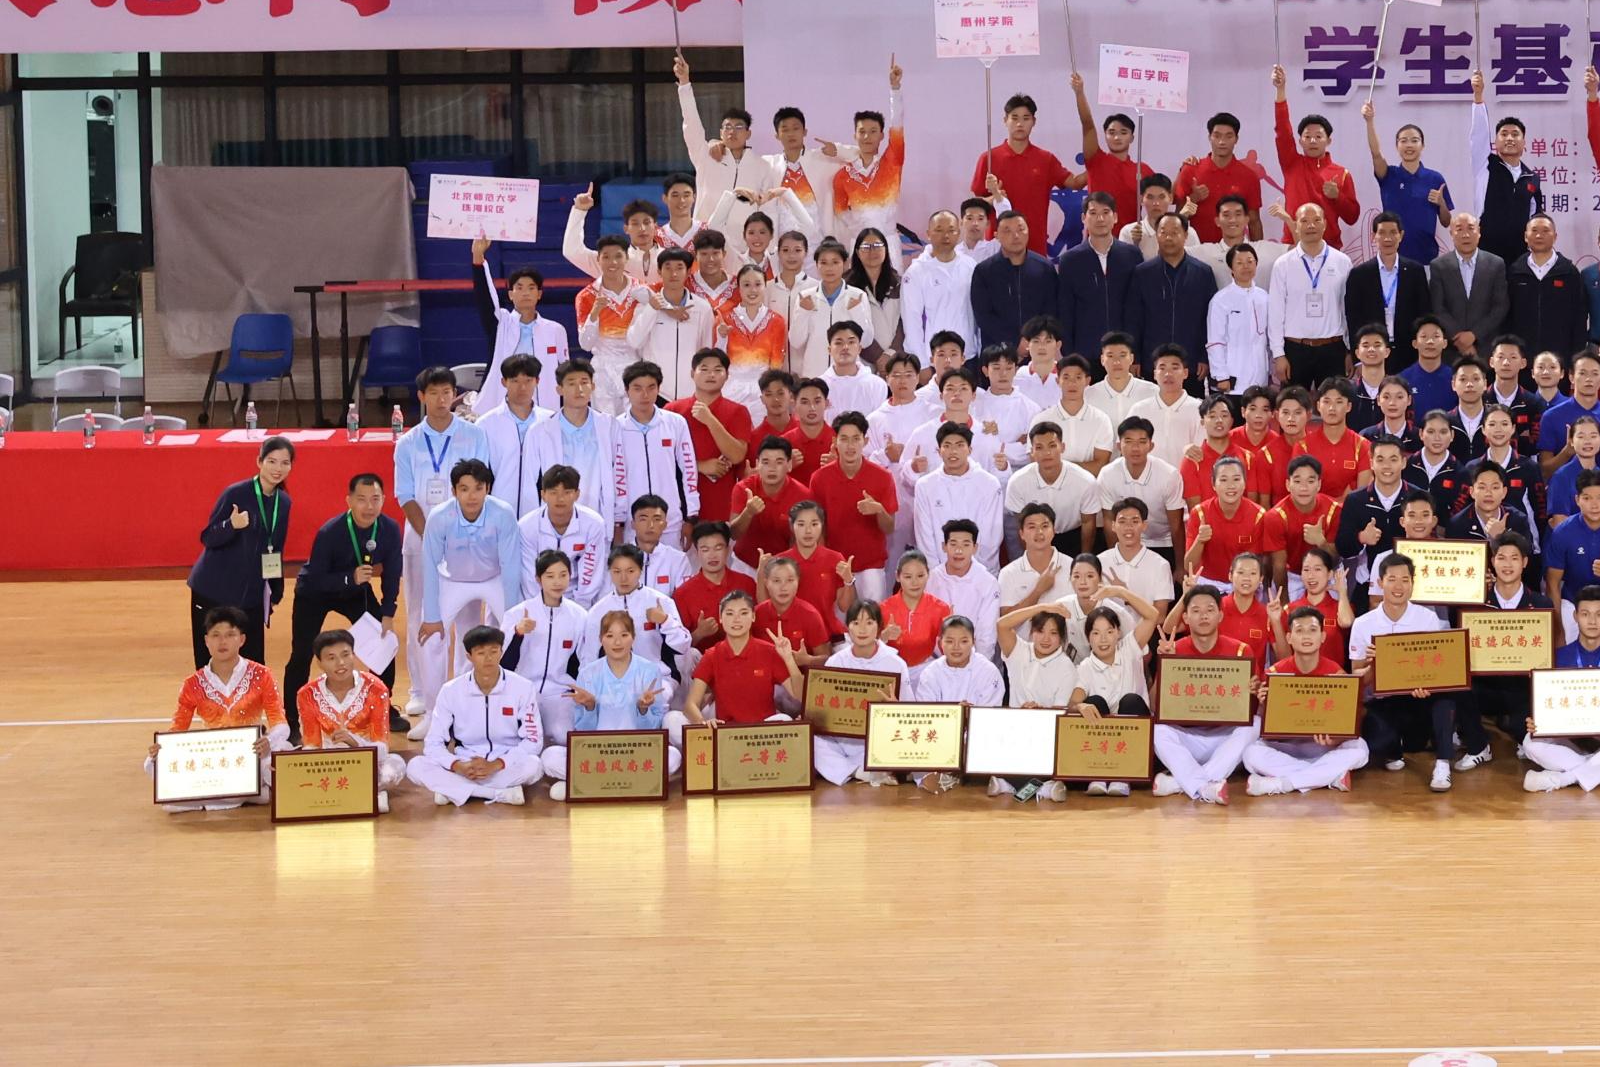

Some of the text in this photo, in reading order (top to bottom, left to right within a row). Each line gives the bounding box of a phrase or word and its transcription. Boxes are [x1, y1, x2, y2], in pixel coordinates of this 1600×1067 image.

[1471, 634, 1543, 648] 道德风尚奖
[1169, 682, 1241, 698] 道德风尚奖
[1288, 697, 1336, 711] 一等奖
[890, 728, 938, 743] 三等奖
[1080, 740, 1127, 755] 三等奖
[168, 755, 247, 774] 道德风尚奖
[740, 749, 788, 765] 二等奖
[579, 758, 655, 774] 道德风尚奖
[299, 776, 350, 792] 一等奖
